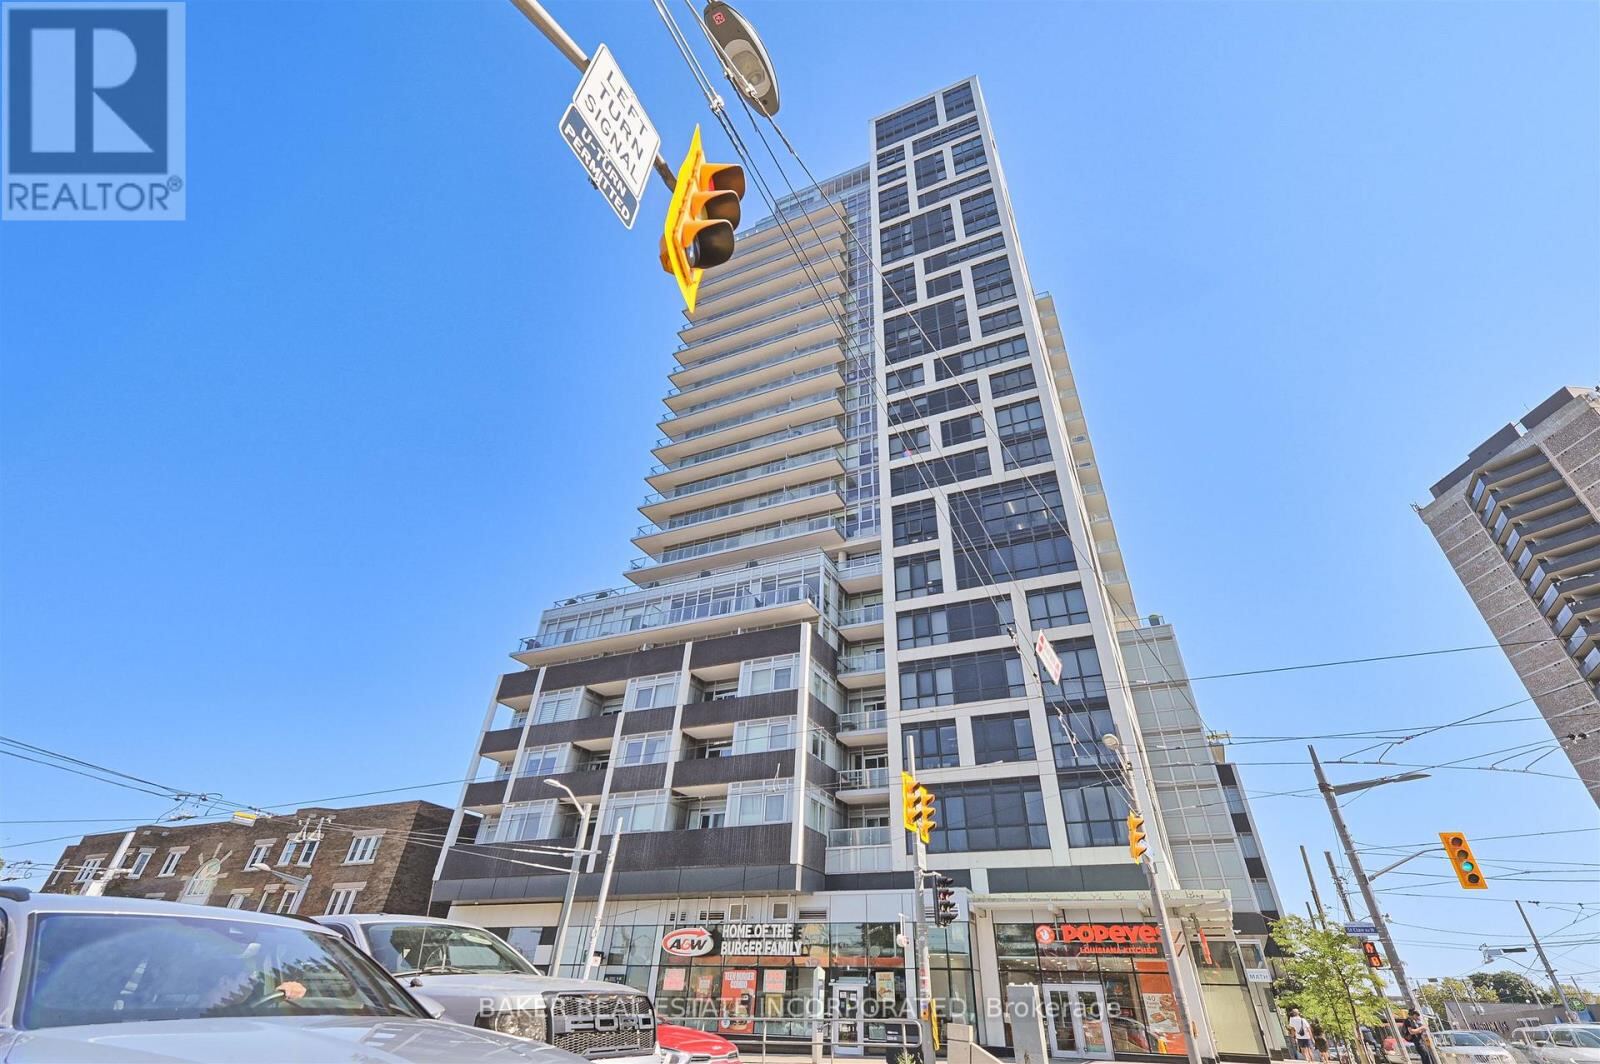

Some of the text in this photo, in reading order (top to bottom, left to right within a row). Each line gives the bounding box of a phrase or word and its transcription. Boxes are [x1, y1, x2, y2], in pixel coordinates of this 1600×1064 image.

[600, 81, 644, 160] TURN
[606, 70, 648, 136] LEFT
[584, 94, 638, 184] SIGNAL
[564, 123, 630, 221] PERMITTED
[581, 127, 627, 197] U-TURN
[670, 939, 708, 951] A&W
[721, 940, 803, 955] BURGER FAMILY
[722, 924, 794, 938] HOME OF THE
[1122, 947, 1158, 955] KITCHEN
[564, 1013, 655, 1033] FORD
